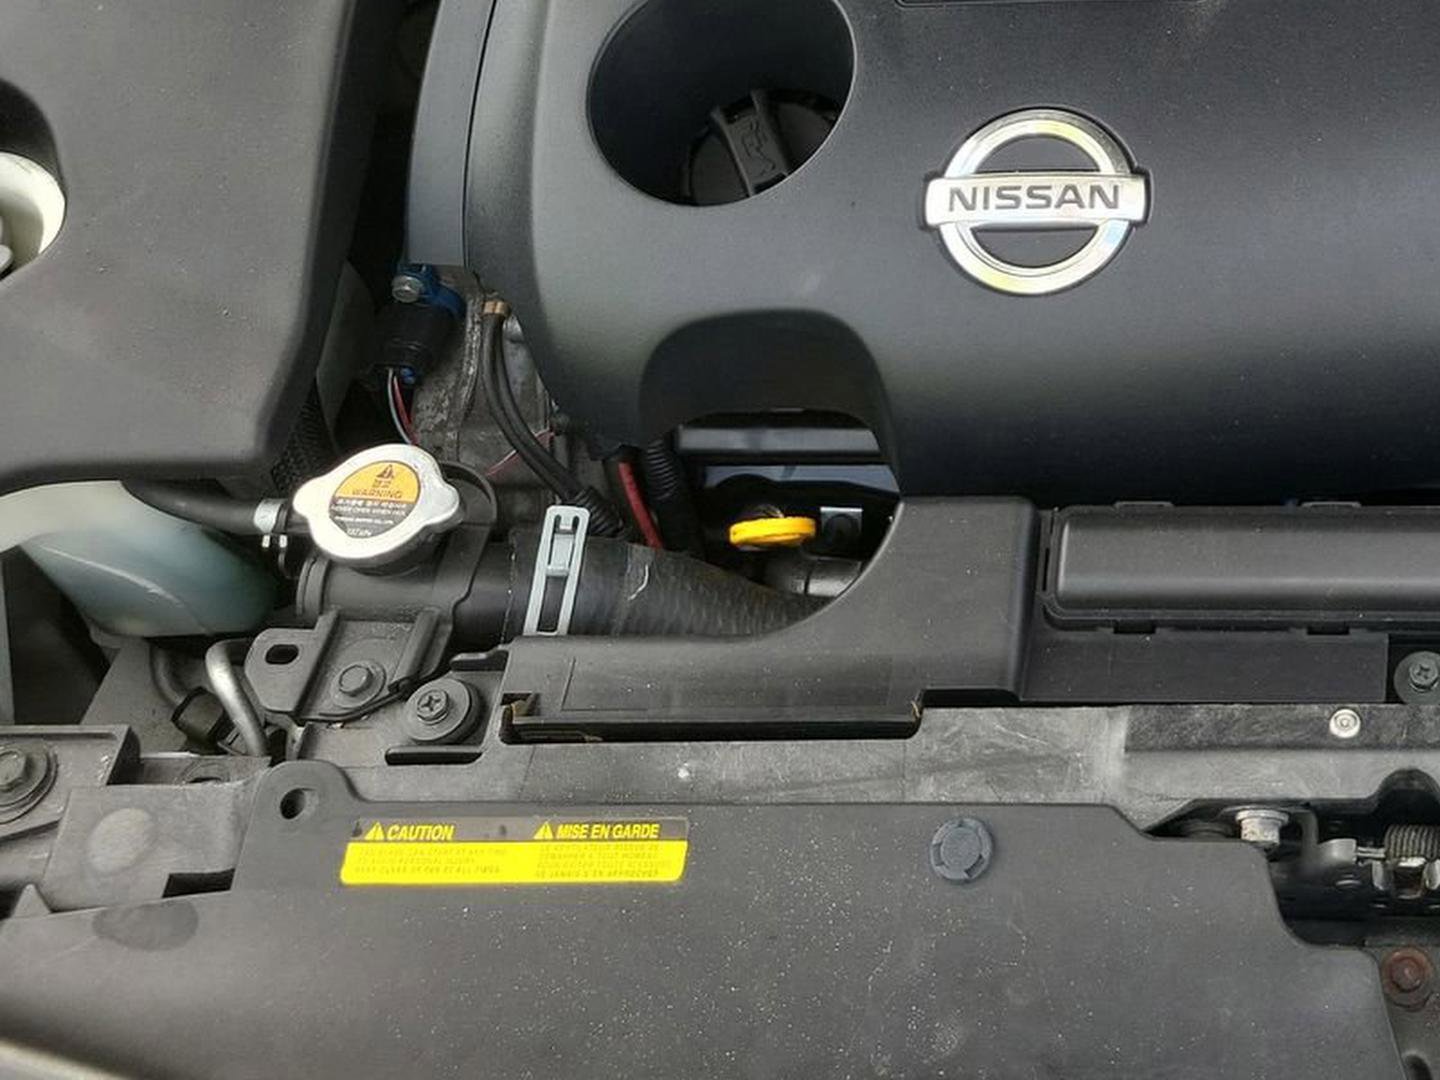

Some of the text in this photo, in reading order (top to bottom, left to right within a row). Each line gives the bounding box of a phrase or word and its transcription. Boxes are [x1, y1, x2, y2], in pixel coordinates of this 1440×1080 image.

[948, 184, 1119, 213] NISSAN
[352, 488, 403, 499] WARNING
[386, 825, 454, 840] CAUTION
[554, 823, 660, 840] MISE EN GARDE
